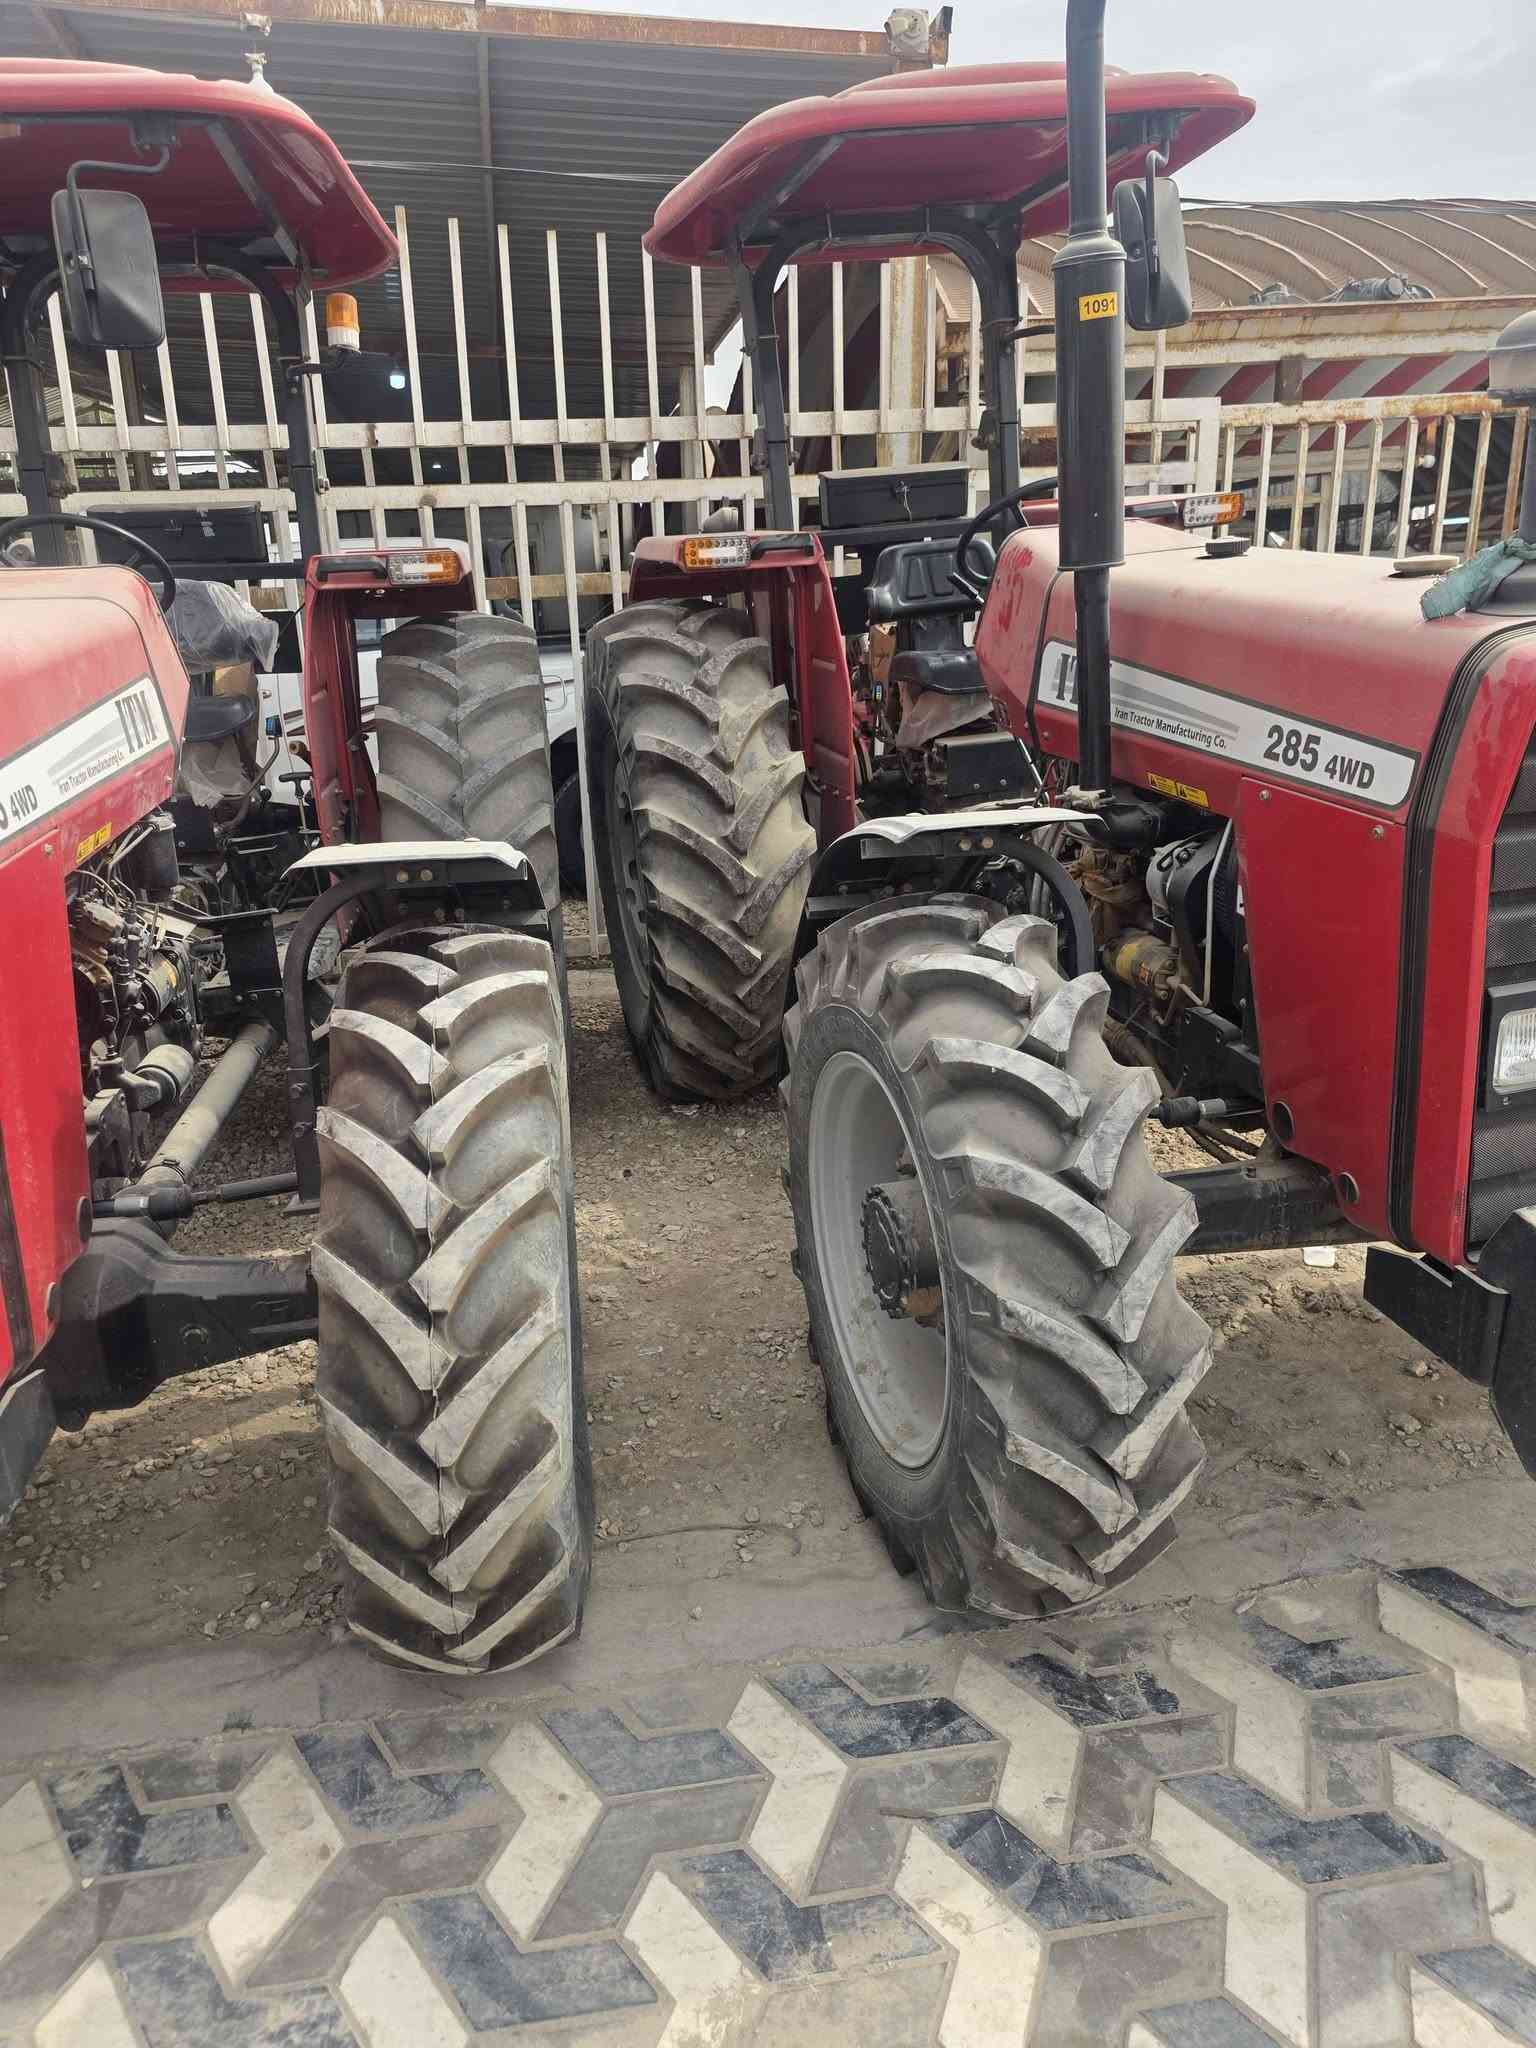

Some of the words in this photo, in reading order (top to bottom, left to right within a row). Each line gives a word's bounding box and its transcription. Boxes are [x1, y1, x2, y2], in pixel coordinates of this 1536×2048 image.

[1084, 298, 1115, 315] 1091
[115, 691, 157, 754] ITM
[1114, 707, 1129, 722] Iran
[1130, 711, 1155, 728] Tractor
[1155, 718, 1212, 747] Manufacturing
[1213, 734, 1227, 750] Co.
[1263, 724, 1321, 772] 285
[1324, 754, 1375, 789] 4WD
[10, 784, 38, 821] 4WD
